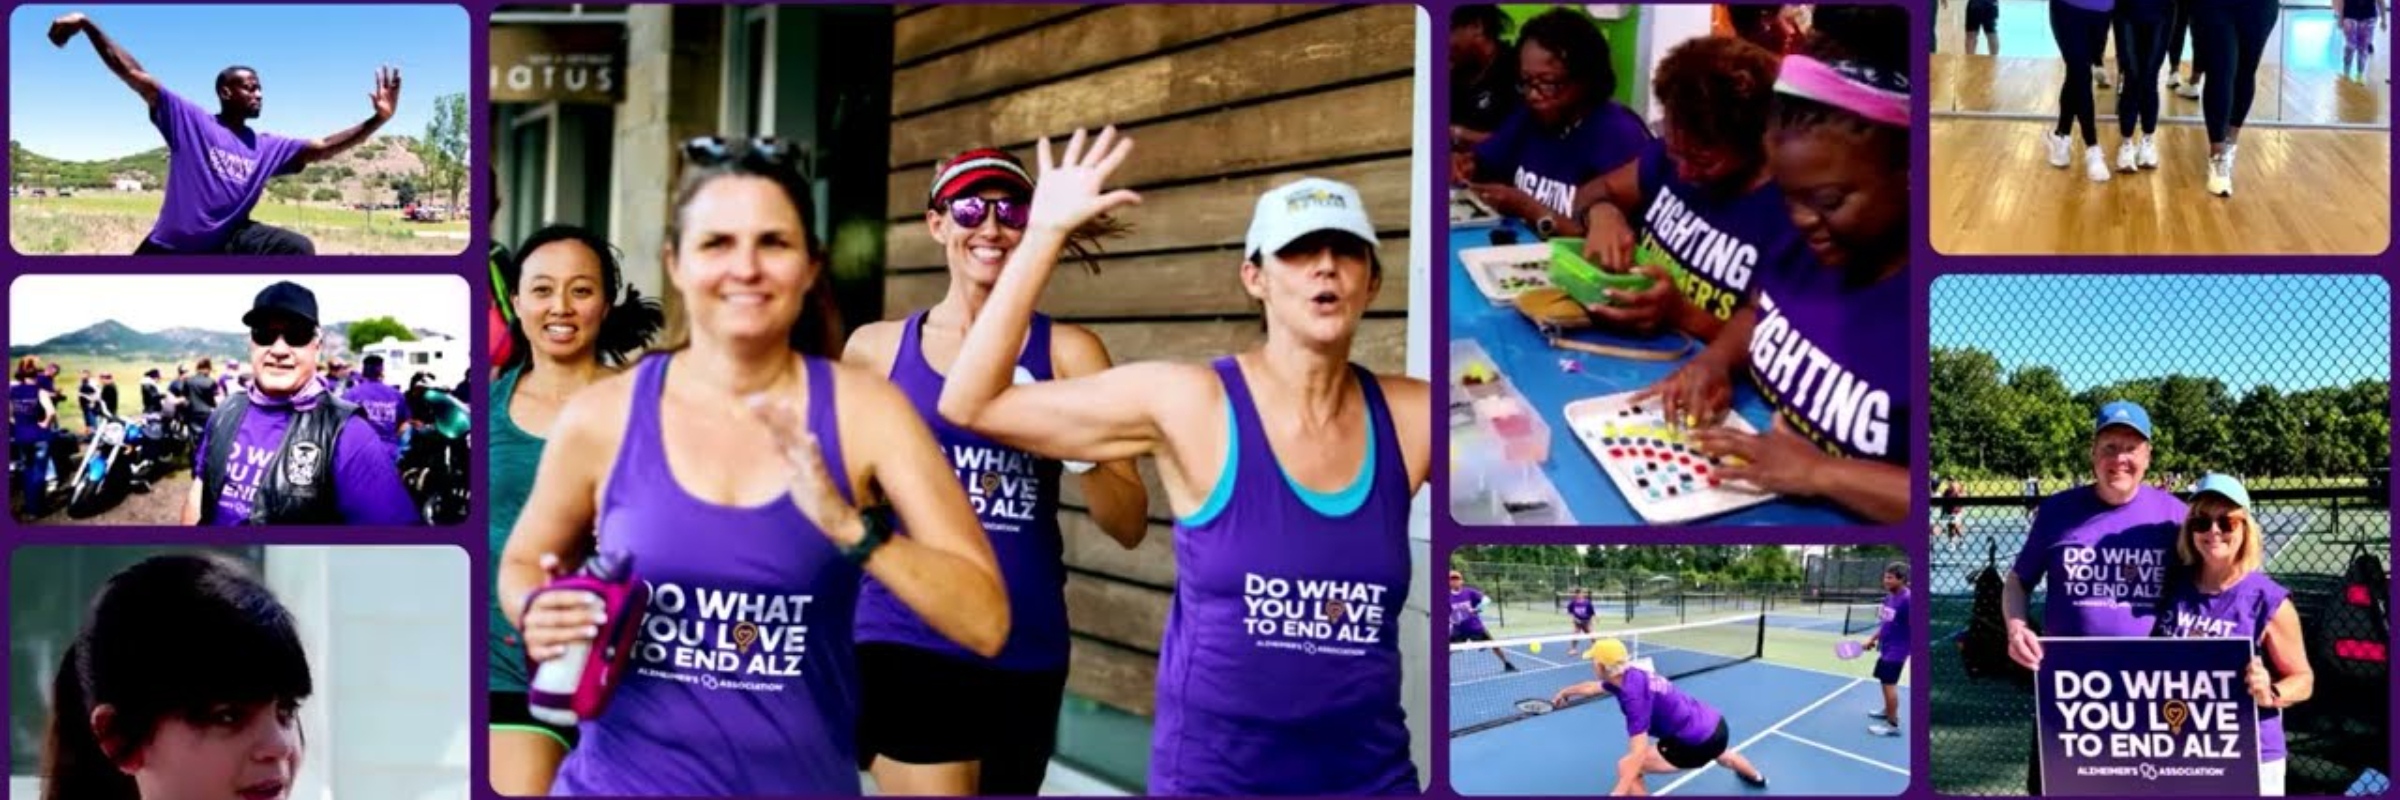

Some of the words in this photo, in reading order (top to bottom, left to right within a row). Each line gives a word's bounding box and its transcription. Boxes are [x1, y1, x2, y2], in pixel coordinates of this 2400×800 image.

[1645, 185, 1758, 290] FIGHTING
[990, 498, 1035, 520] ALZ
[2063, 547, 2097, 564] DO
[2102, 547, 2166, 566] WHAT
[2063, 564, 2108, 581] YOU
[1245, 573, 1290, 598] DO
[1297, 580, 1387, 604] WHAT
[2064, 582, 2089, 596] TO
[2092, 582, 2129, 597] END
[2132, 583, 2163, 598] ALZ
[695, 587, 813, 623] WHAT
[1244, 595, 1305, 619] YOU
[1243, 618, 1277, 636] TO
[1283, 620, 1332, 640] END
[1337, 624, 1380, 643] ALZ
[675, 646, 740, 671] END
[746, 653, 802, 676] ALZ
[2054, 670, 2112, 700] DO
[2120, 670, 2236, 700] WHAT
[2055, 701, 2136, 731] YOU
[2058, 733, 2103, 758] TO
[2110, 733, 2175, 758] END
[2182, 733, 2241, 758] ALZ
[2077, 766, 2138, 776] ALZHEIMER'S
[2159, 766, 2226, 776] ASSOCIATION
